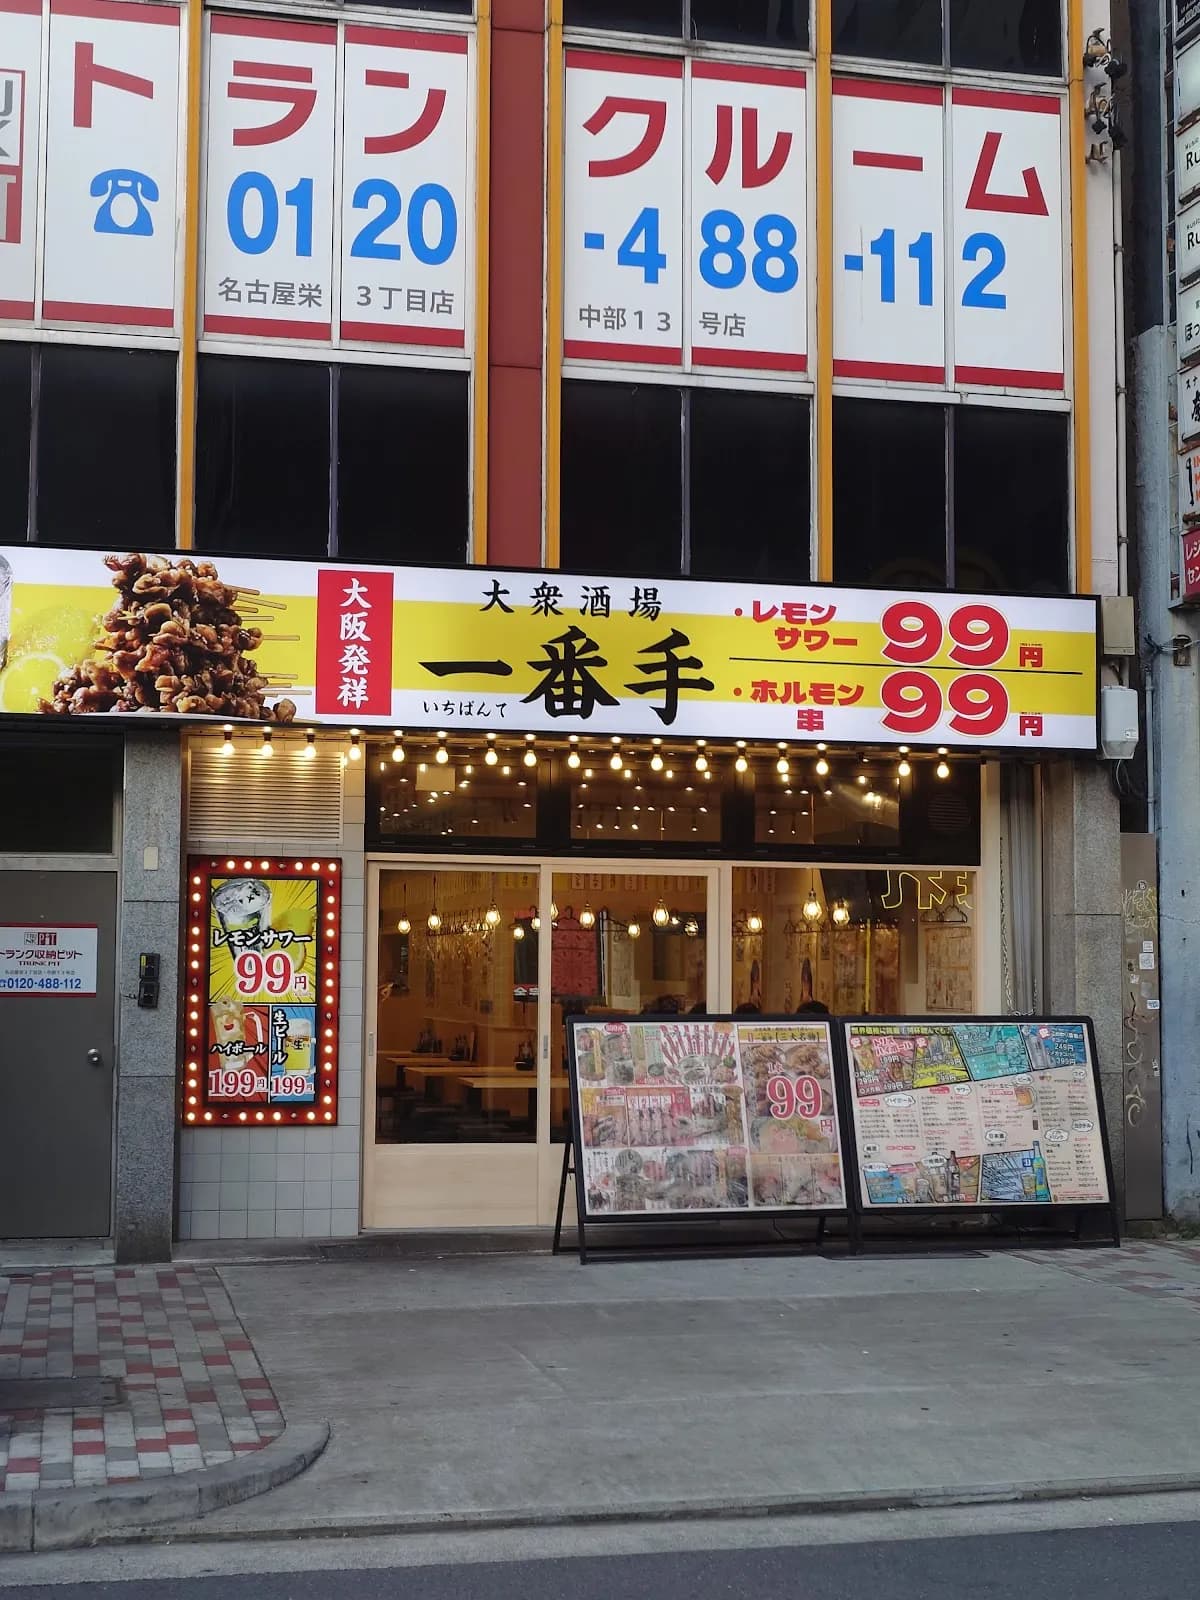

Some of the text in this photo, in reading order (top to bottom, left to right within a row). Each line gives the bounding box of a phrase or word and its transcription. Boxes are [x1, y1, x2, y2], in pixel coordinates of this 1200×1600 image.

[479, 579, 663, 622] 大衆酒場
[336, 578, 372, 710] 大阪発祥
[774, 627, 858, 651] サワー
[417, 625, 715, 727] 一番手
[797, 708, 825, 732] 串
[212, 930, 312, 948] レモンサワー
[210, 1040, 267, 1056] ハイボール
[272, 1009, 288, 1064] 生ビール
